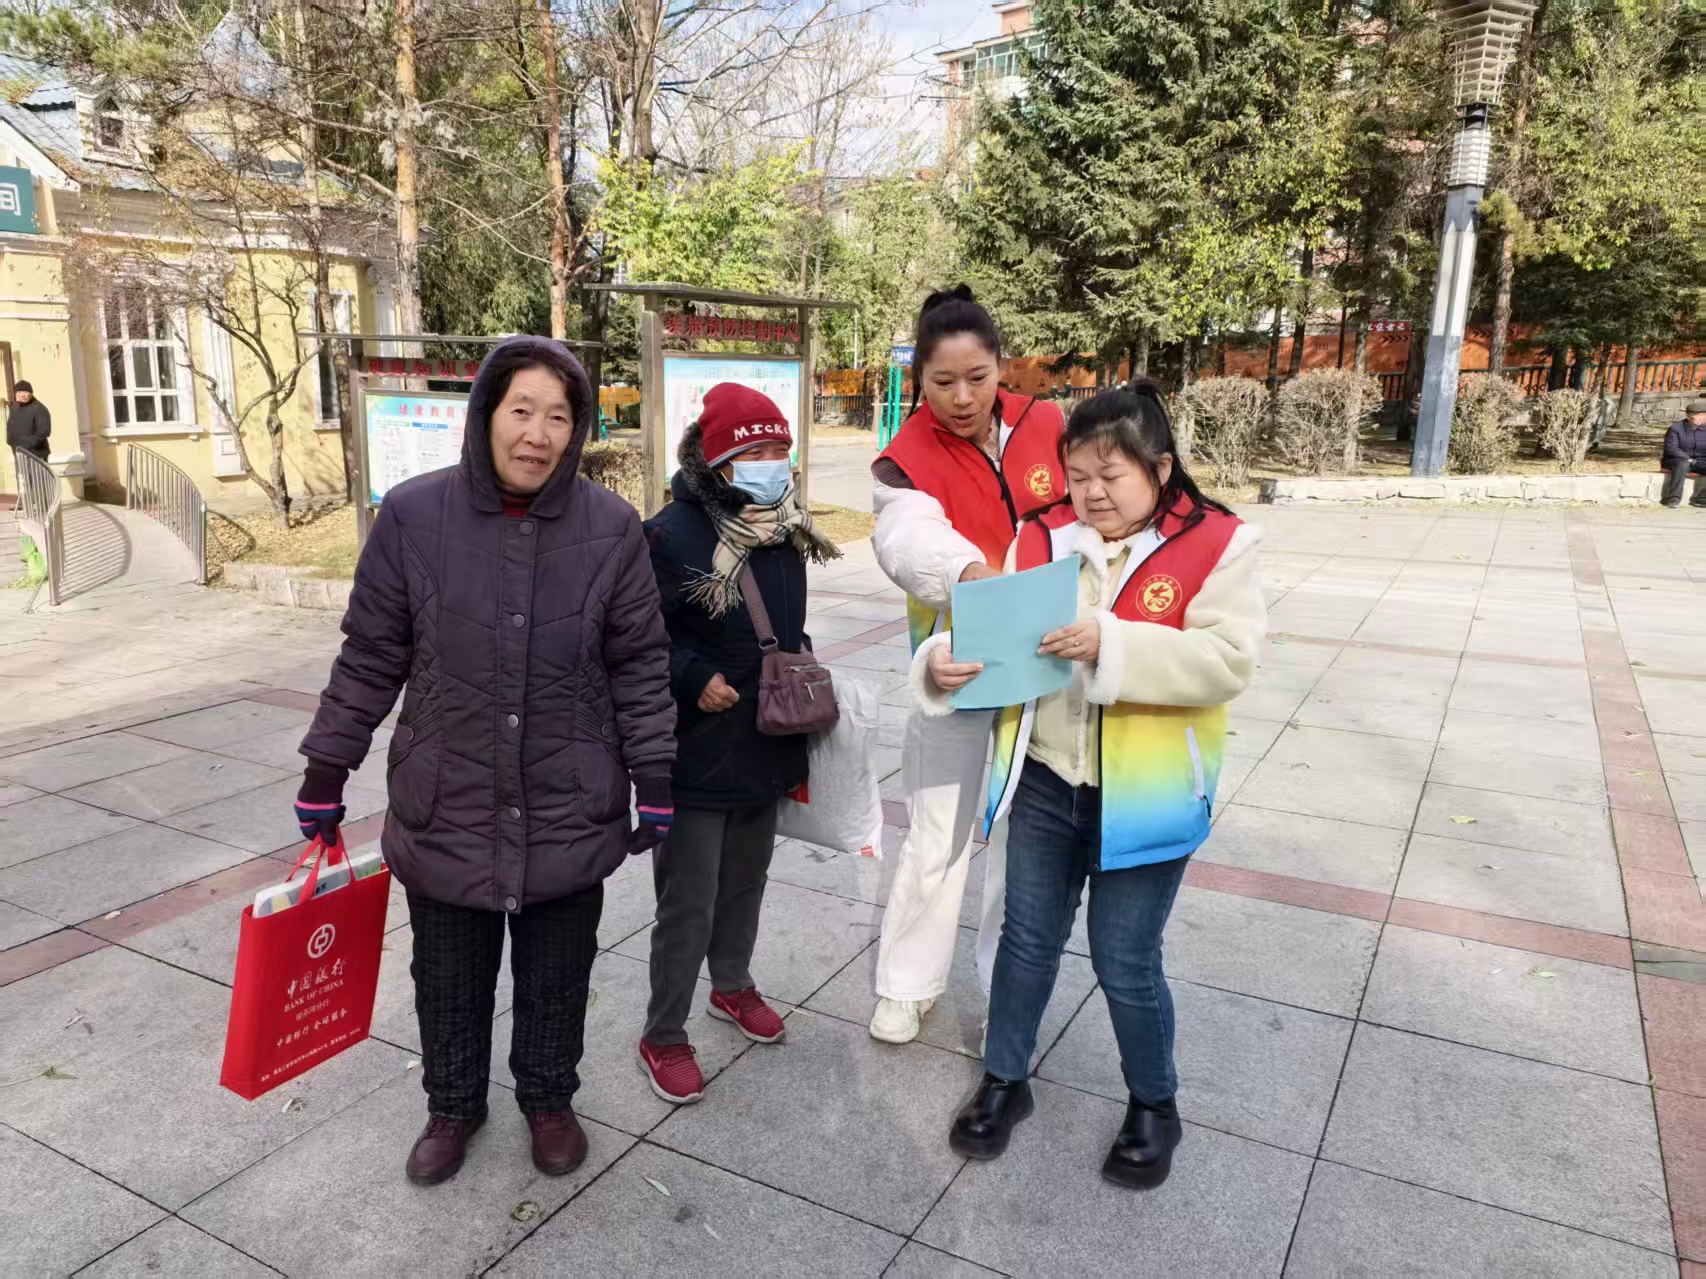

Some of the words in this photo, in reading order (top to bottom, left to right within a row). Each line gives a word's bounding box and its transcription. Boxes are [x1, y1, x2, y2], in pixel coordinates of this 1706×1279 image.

[665, 314, 801, 342] 疾病预防控制中心
[287, 958, 346, 999] 中国银行
[284, 996, 305, 1013] BANK
[306, 989, 318, 1001] OF
[319, 979, 344, 996] CHINA
